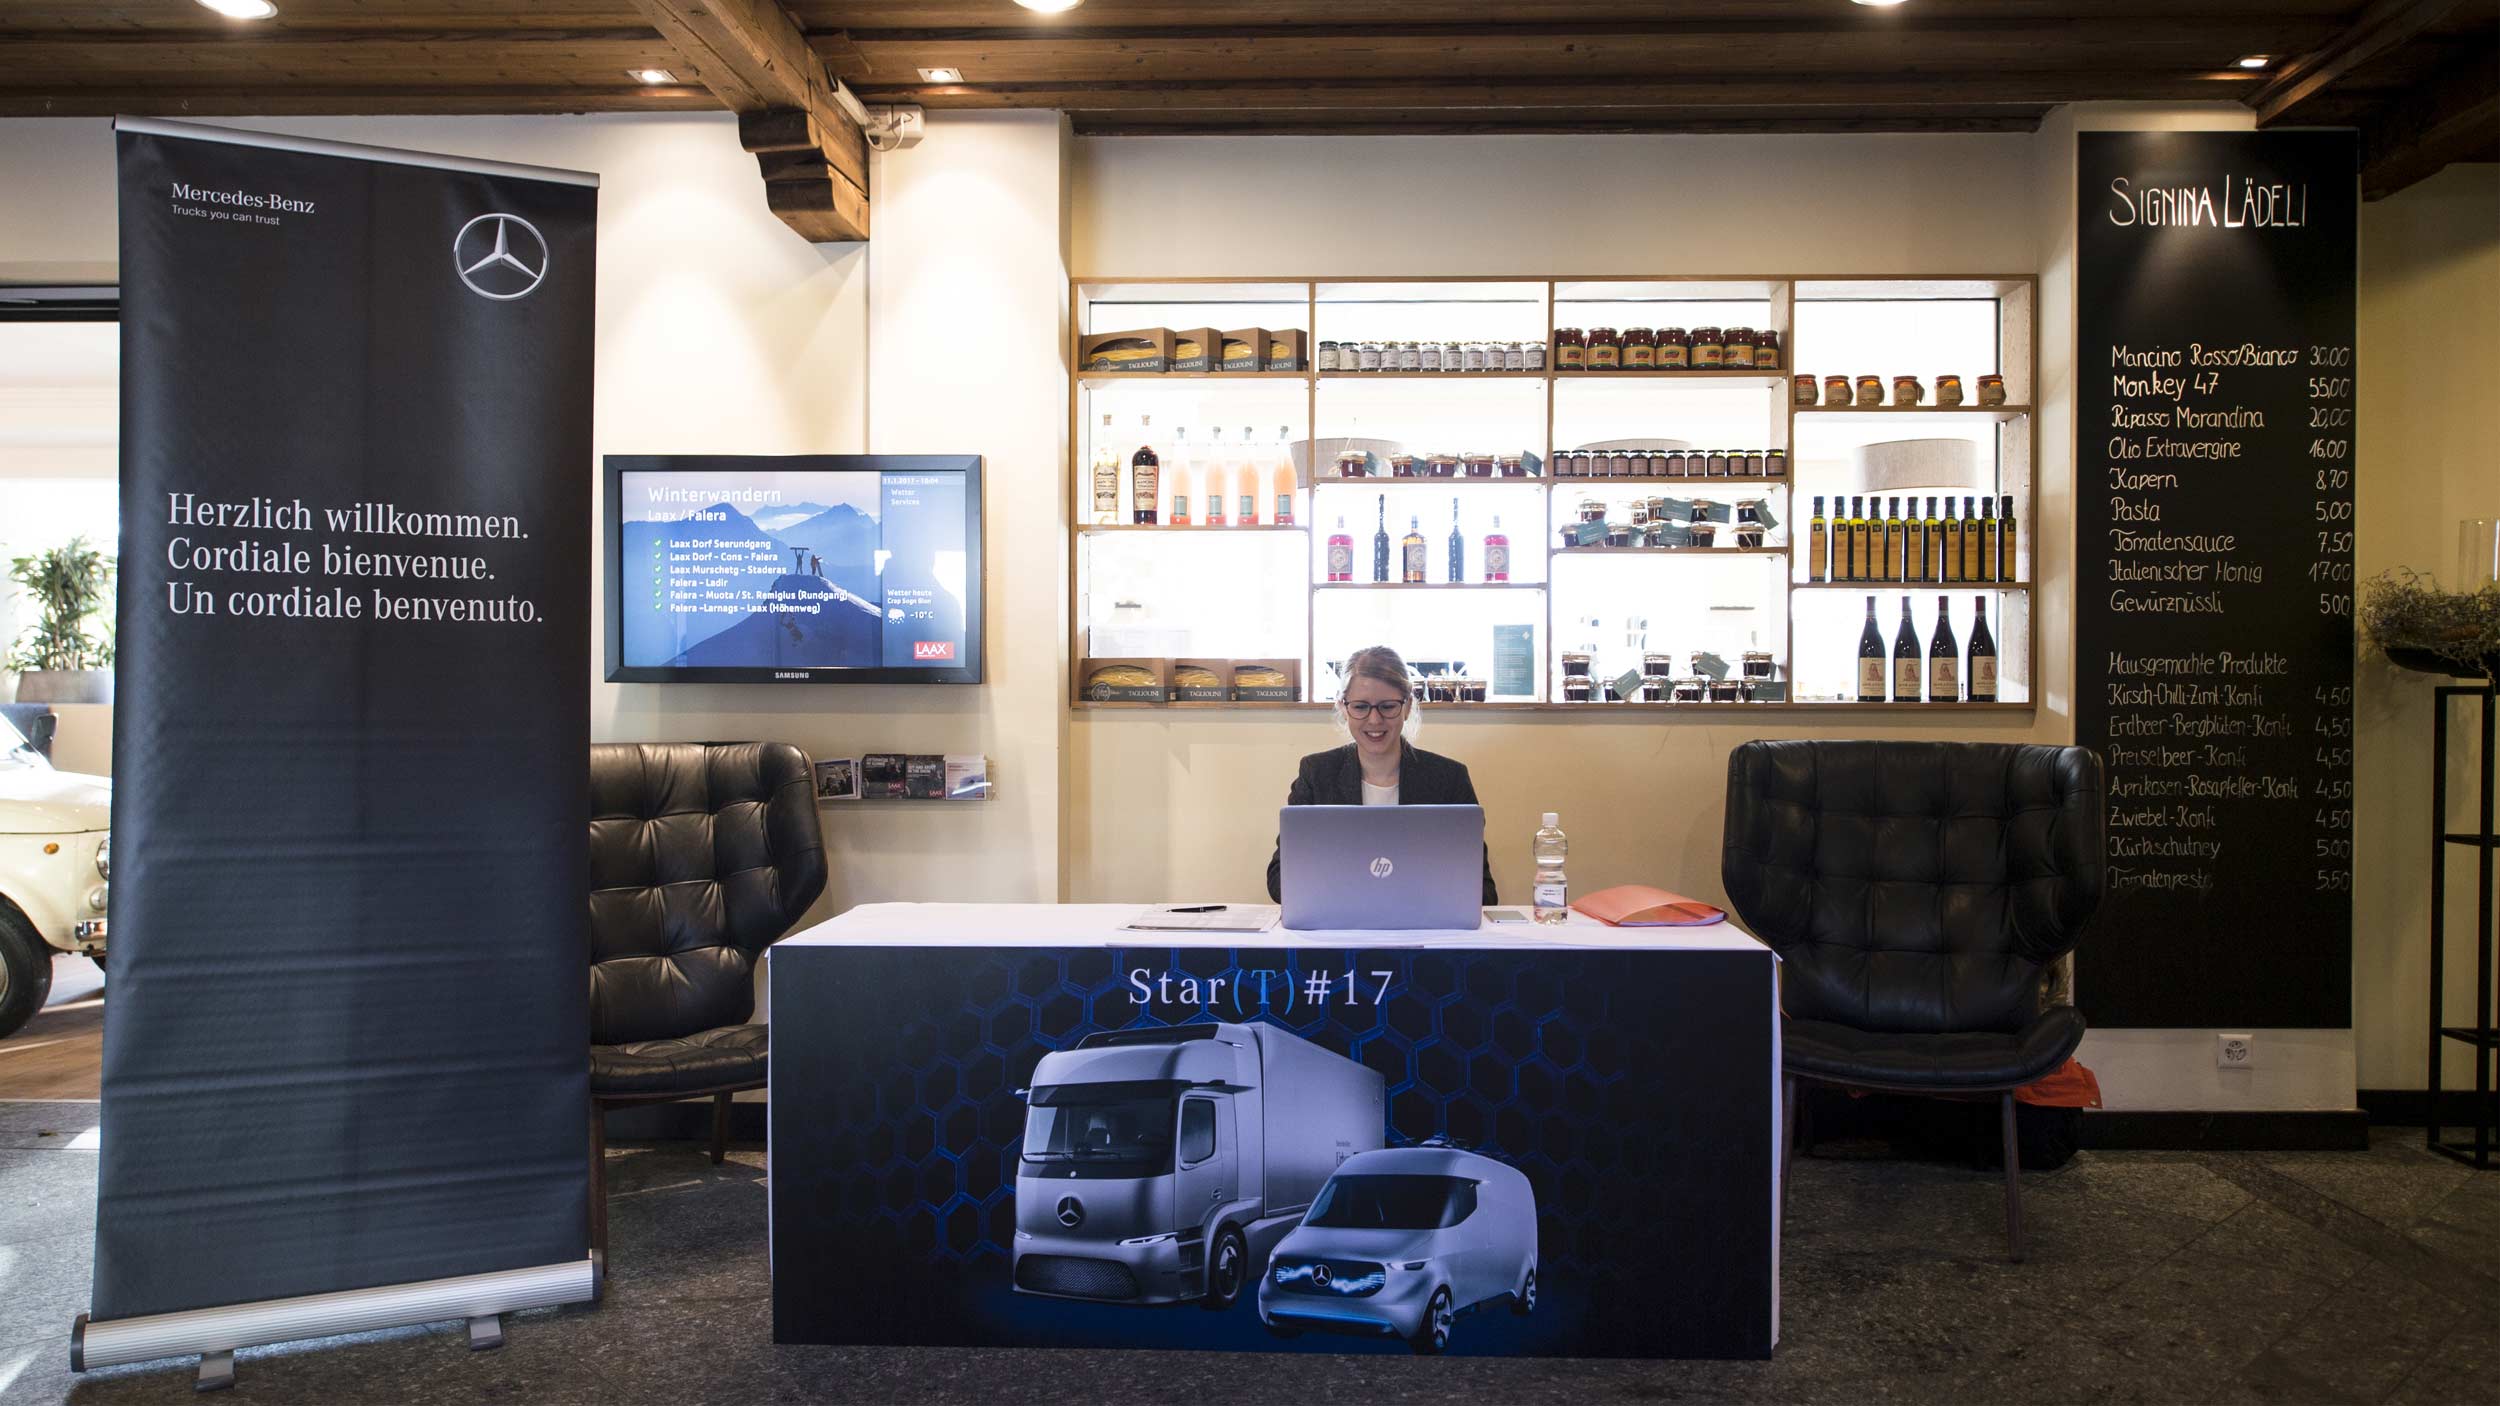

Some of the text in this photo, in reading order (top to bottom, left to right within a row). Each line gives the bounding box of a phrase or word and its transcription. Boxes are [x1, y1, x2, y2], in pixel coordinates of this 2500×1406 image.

[171, 182, 316, 214] Mercedes-Benz
[2109, 174, 2306, 228] SIGNINA LÄDELI
[171, 204, 281, 226] Trucks you can trust
[1128, 360, 1159, 369] TAGLIOLINI
[2112, 345, 2181, 367] Mancino
[2190, 343, 2298, 366] Rosso/Bianco
[2113, 370, 2186, 401] Monkey
[2194, 372, 2220, 395] 47
[2111, 404, 2170, 429] Ripasso
[2176, 405, 2264, 429] Morandina
[2109, 436, 2141, 459] Olio
[2146, 436, 2241, 460] Extravergine
[2109, 467, 2178, 490] Kapern
[648, 487, 781, 502] Winterwandern
[167, 491, 530, 540] Herzlich willkommen.
[648, 510, 676, 521] Laax
[688, 510, 727, 521] Falera
[2110, 496, 2160, 521] Pasta
[670, 539, 772, 550] Laax Dorf Seerundgang
[2109, 528, 2236, 552] Tomatensauce
[166, 536, 496, 582] Cordiale bienvenue.
[670, 553, 690, 561] Laax
[692, 552, 713, 561] Dorf
[720, 553, 742, 561] Cons
[751, 552, 778, 561] Falera
[670, 566, 690, 574] Laax
[747, 565, 787, 574] Staderas
[2215, 560, 2263, 583] Honig
[670, 579, 697, 587] Falera
[706, 578, 728, 587] Ladir
[166, 581, 544, 624] Un cordiale benvenuto.
[670, 591, 697, 600] Falera
[706, 591, 734, 600] Muota
[756, 590, 796, 601] Remigius
[798, 590, 848, 601] (Rundgang)
[670, 604, 697, 612] Falera
[747, 604, 768, 612] Laax
[769, 602, 821, 614] (Höhenweg)
[916, 643, 946, 655] LAAX
[2107, 651, 2288, 677] Hausgemachte Produkte
[1371, 856, 1392, 878] hp
